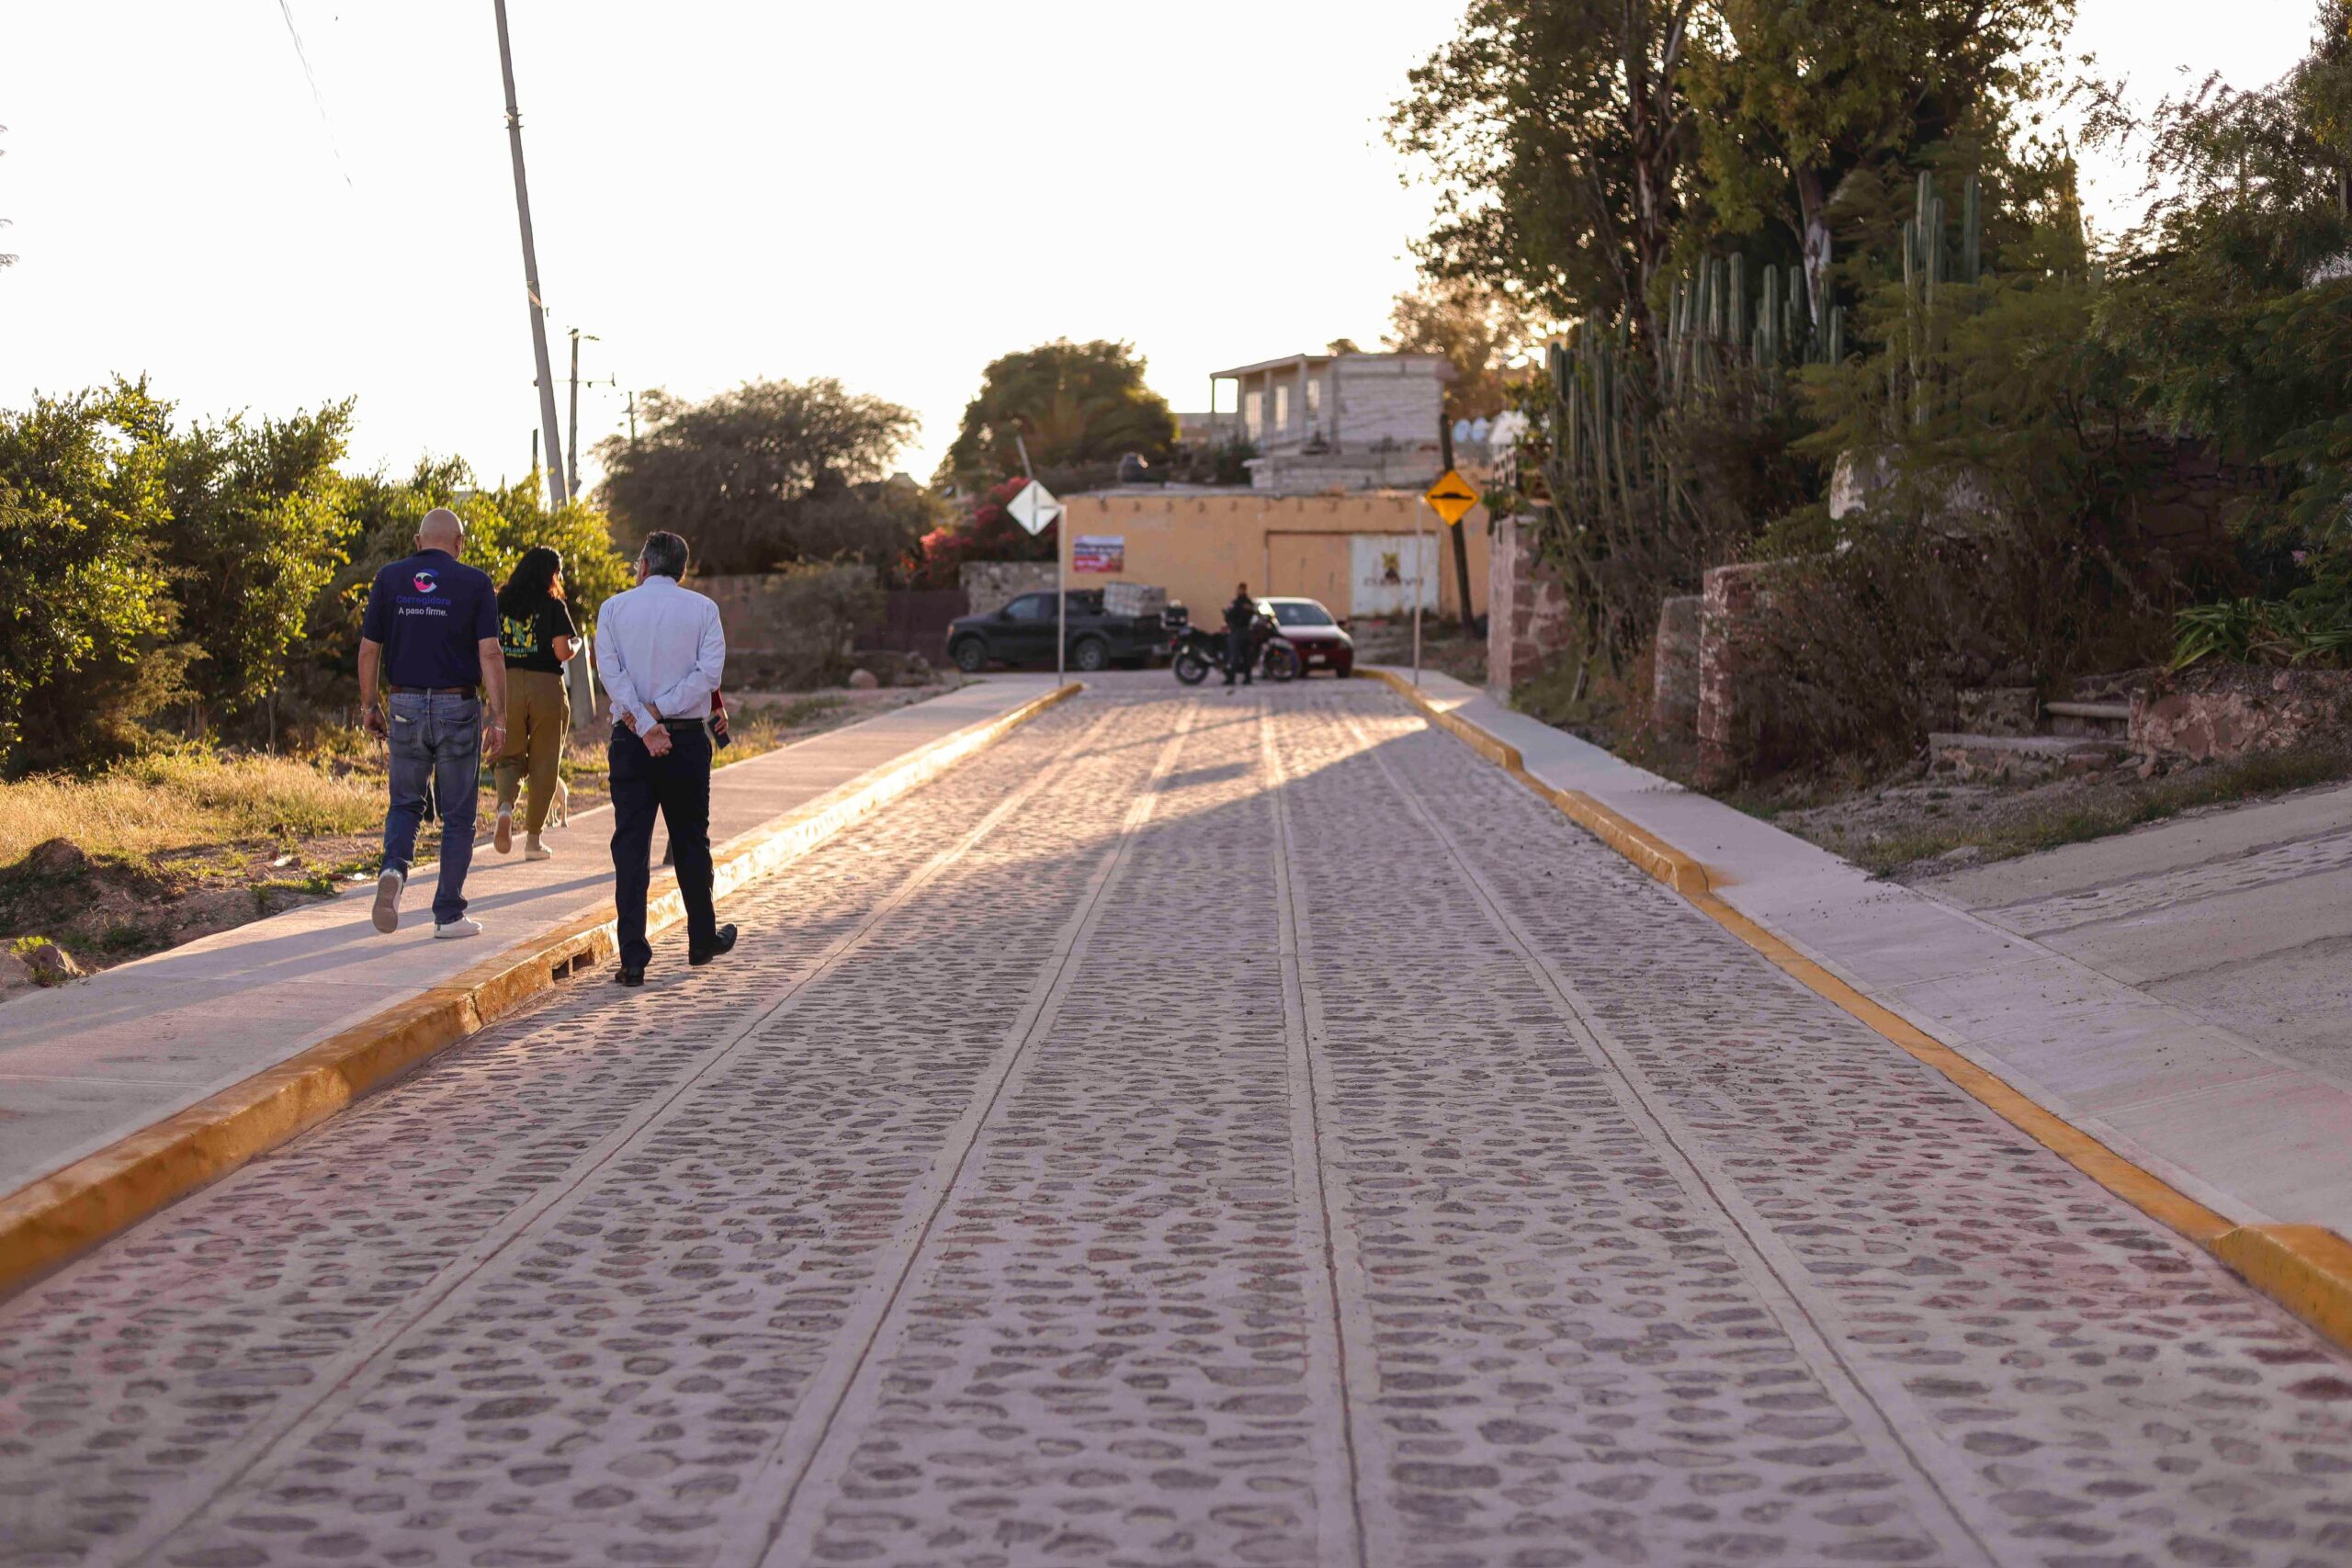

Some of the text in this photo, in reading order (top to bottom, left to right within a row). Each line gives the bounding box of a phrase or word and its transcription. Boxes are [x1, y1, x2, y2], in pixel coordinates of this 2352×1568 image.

[396, 595, 452, 606] Corregidora
[398, 606, 448, 616] A paso firme.
